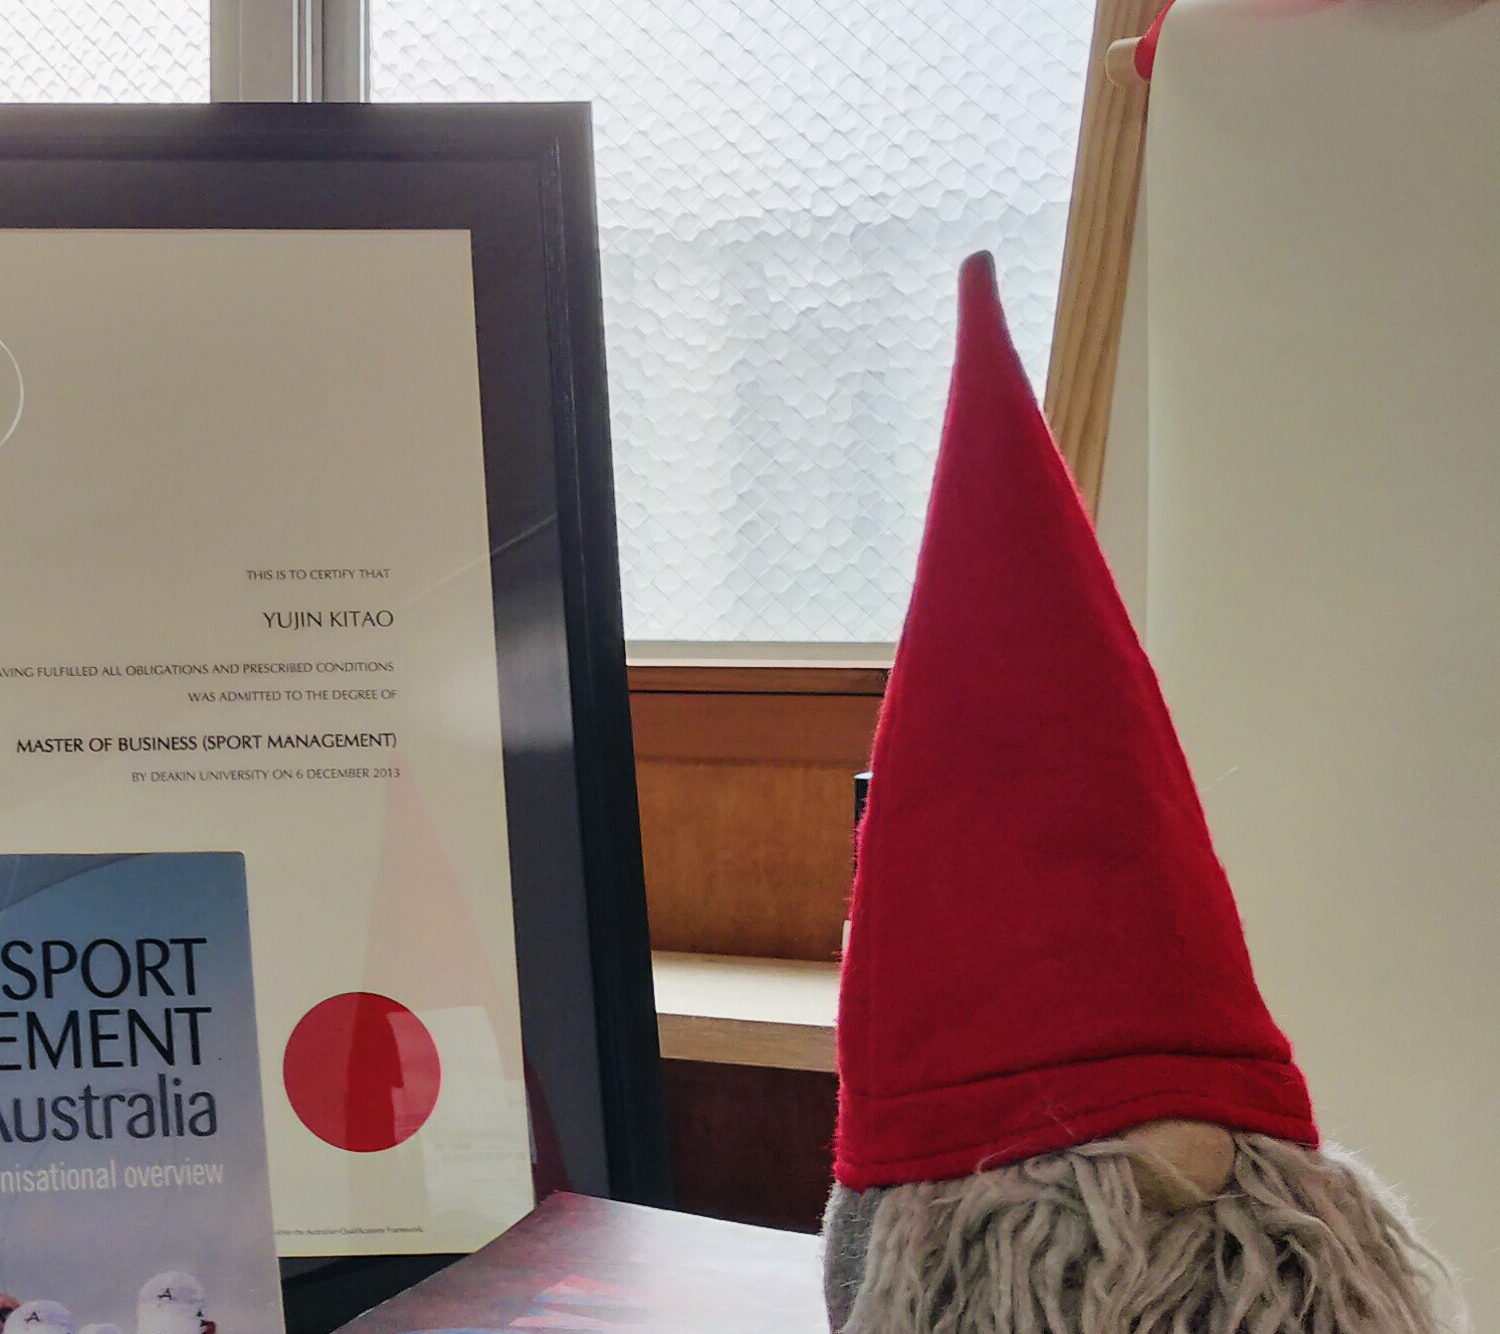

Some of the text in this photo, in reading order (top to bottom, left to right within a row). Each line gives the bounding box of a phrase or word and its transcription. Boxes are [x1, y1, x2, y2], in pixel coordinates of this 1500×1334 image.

[247, 568, 390, 581] THIS IS TO CERTIFY THAT
[263, 609, 394, 630] YUJIN KITAO
[37, 665, 98, 677] FULFILLED
[103, 665, 123, 676] ALL
[125, 664, 209, 676] OBLIGATIONS
[212, 664, 240, 675] AND
[242, 662, 313, 674] PRESCRIBED
[316, 661, 395, 673] CONDITIONS
[188, 688, 398, 703] WAS ADMITTED TO THE DEGREE OF
[16, 732, 398, 753] MASTER OF BUSINESS (SPORT MANAGEMENT)
[131, 767, 401, 783] BY DEAKIN UNIVERSITY ON 6 DECEMBER 2013
[0, 937, 207, 1001] SPORT
[124, 1160, 225, 1190] overview
